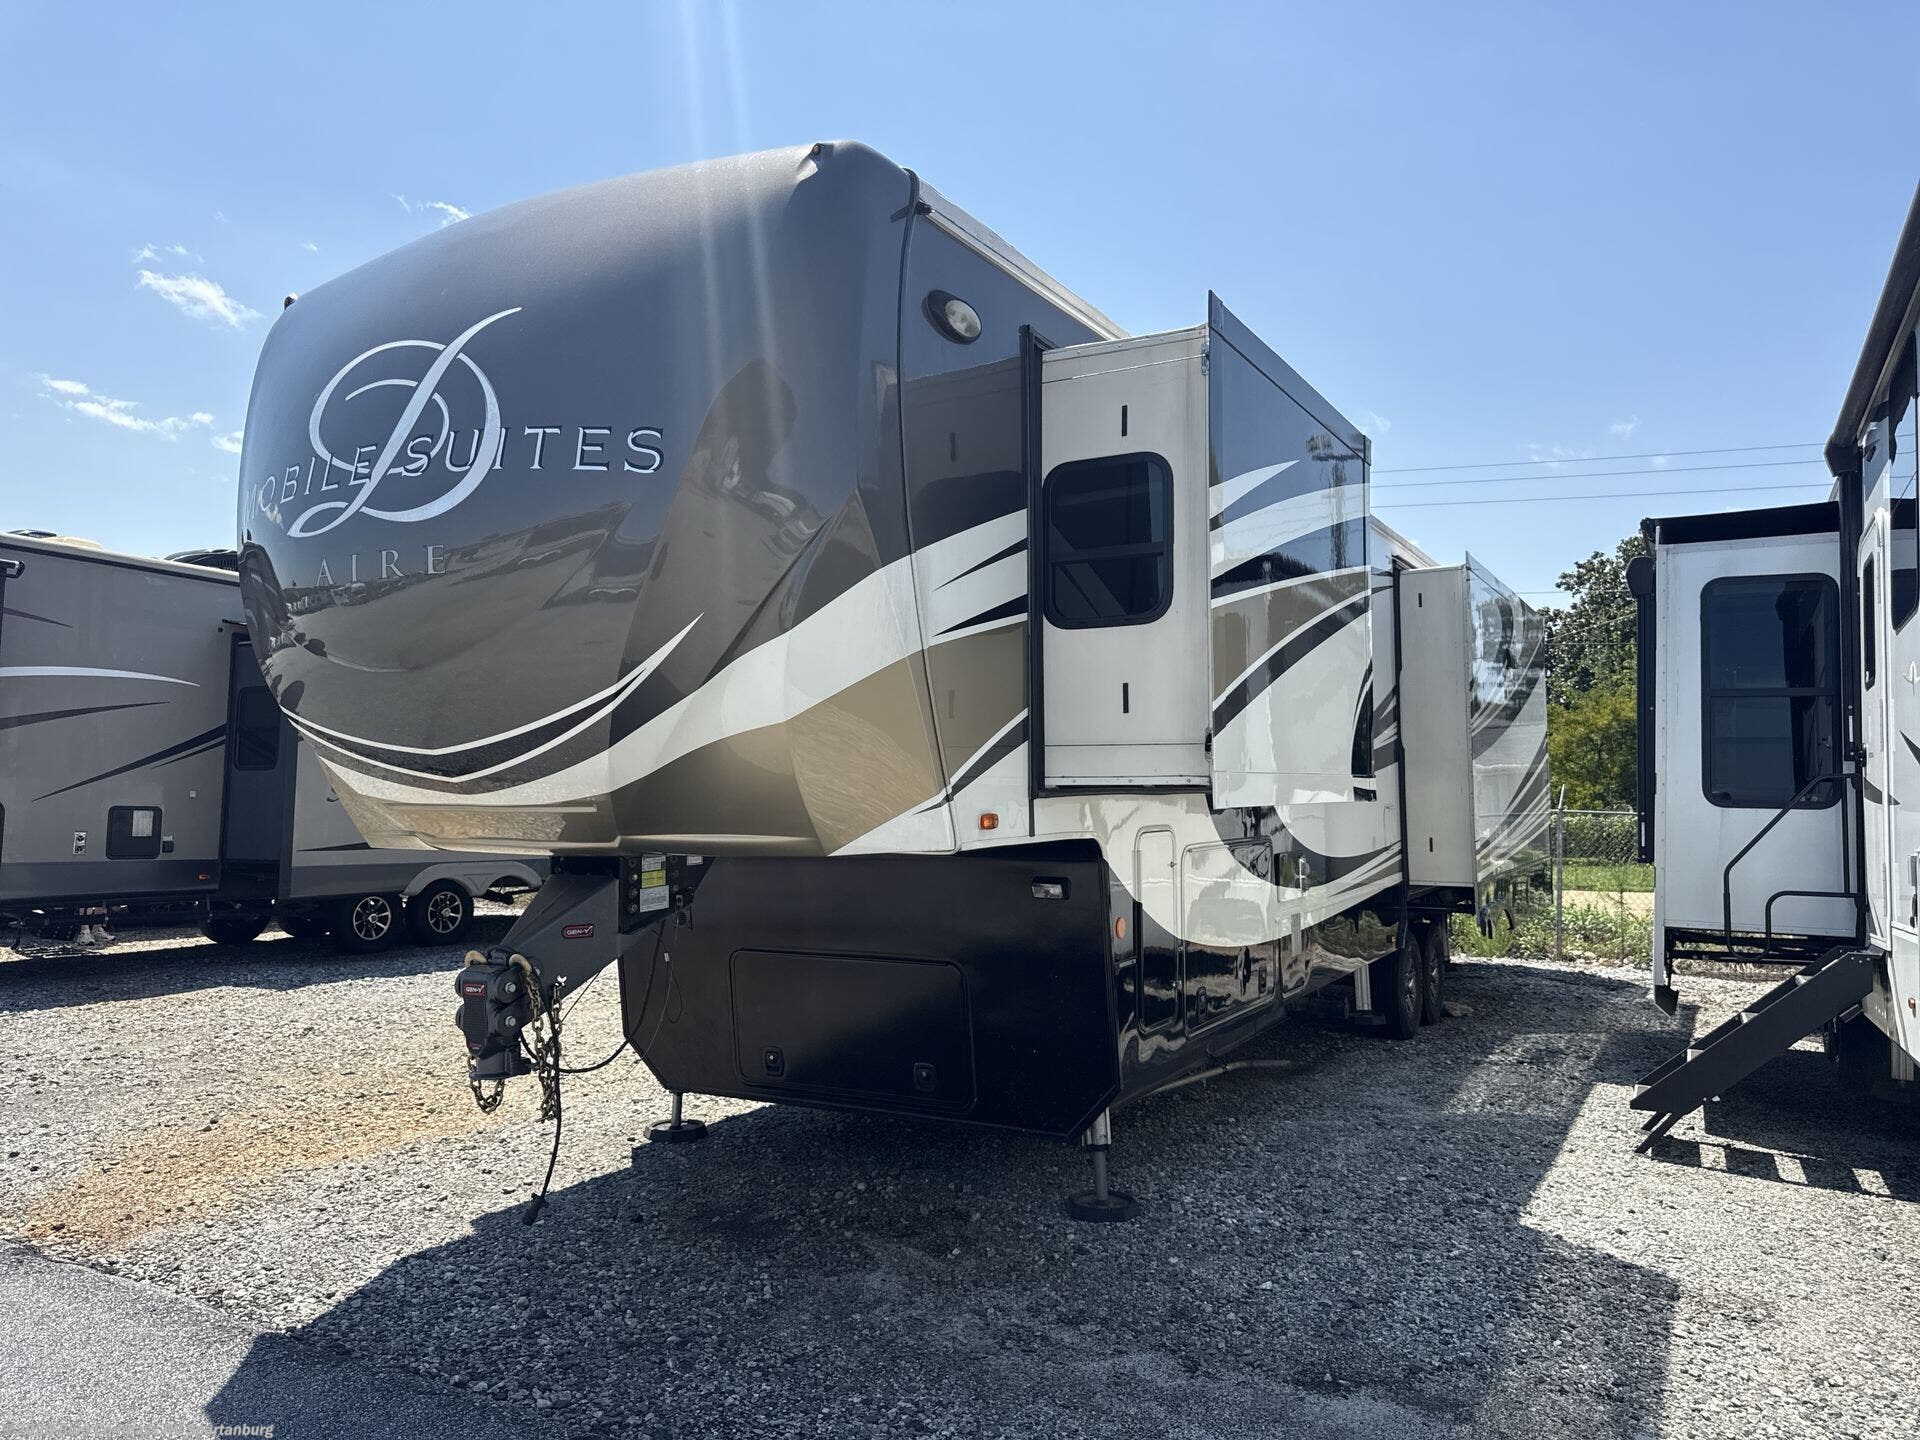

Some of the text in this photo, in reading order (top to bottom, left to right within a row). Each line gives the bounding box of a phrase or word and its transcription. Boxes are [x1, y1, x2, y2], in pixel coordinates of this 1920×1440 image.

[244, 425, 666, 522] MOBILE SUITES
[315, 544, 447, 586] AIRE
[566, 925, 594, 936] GEN-Y
